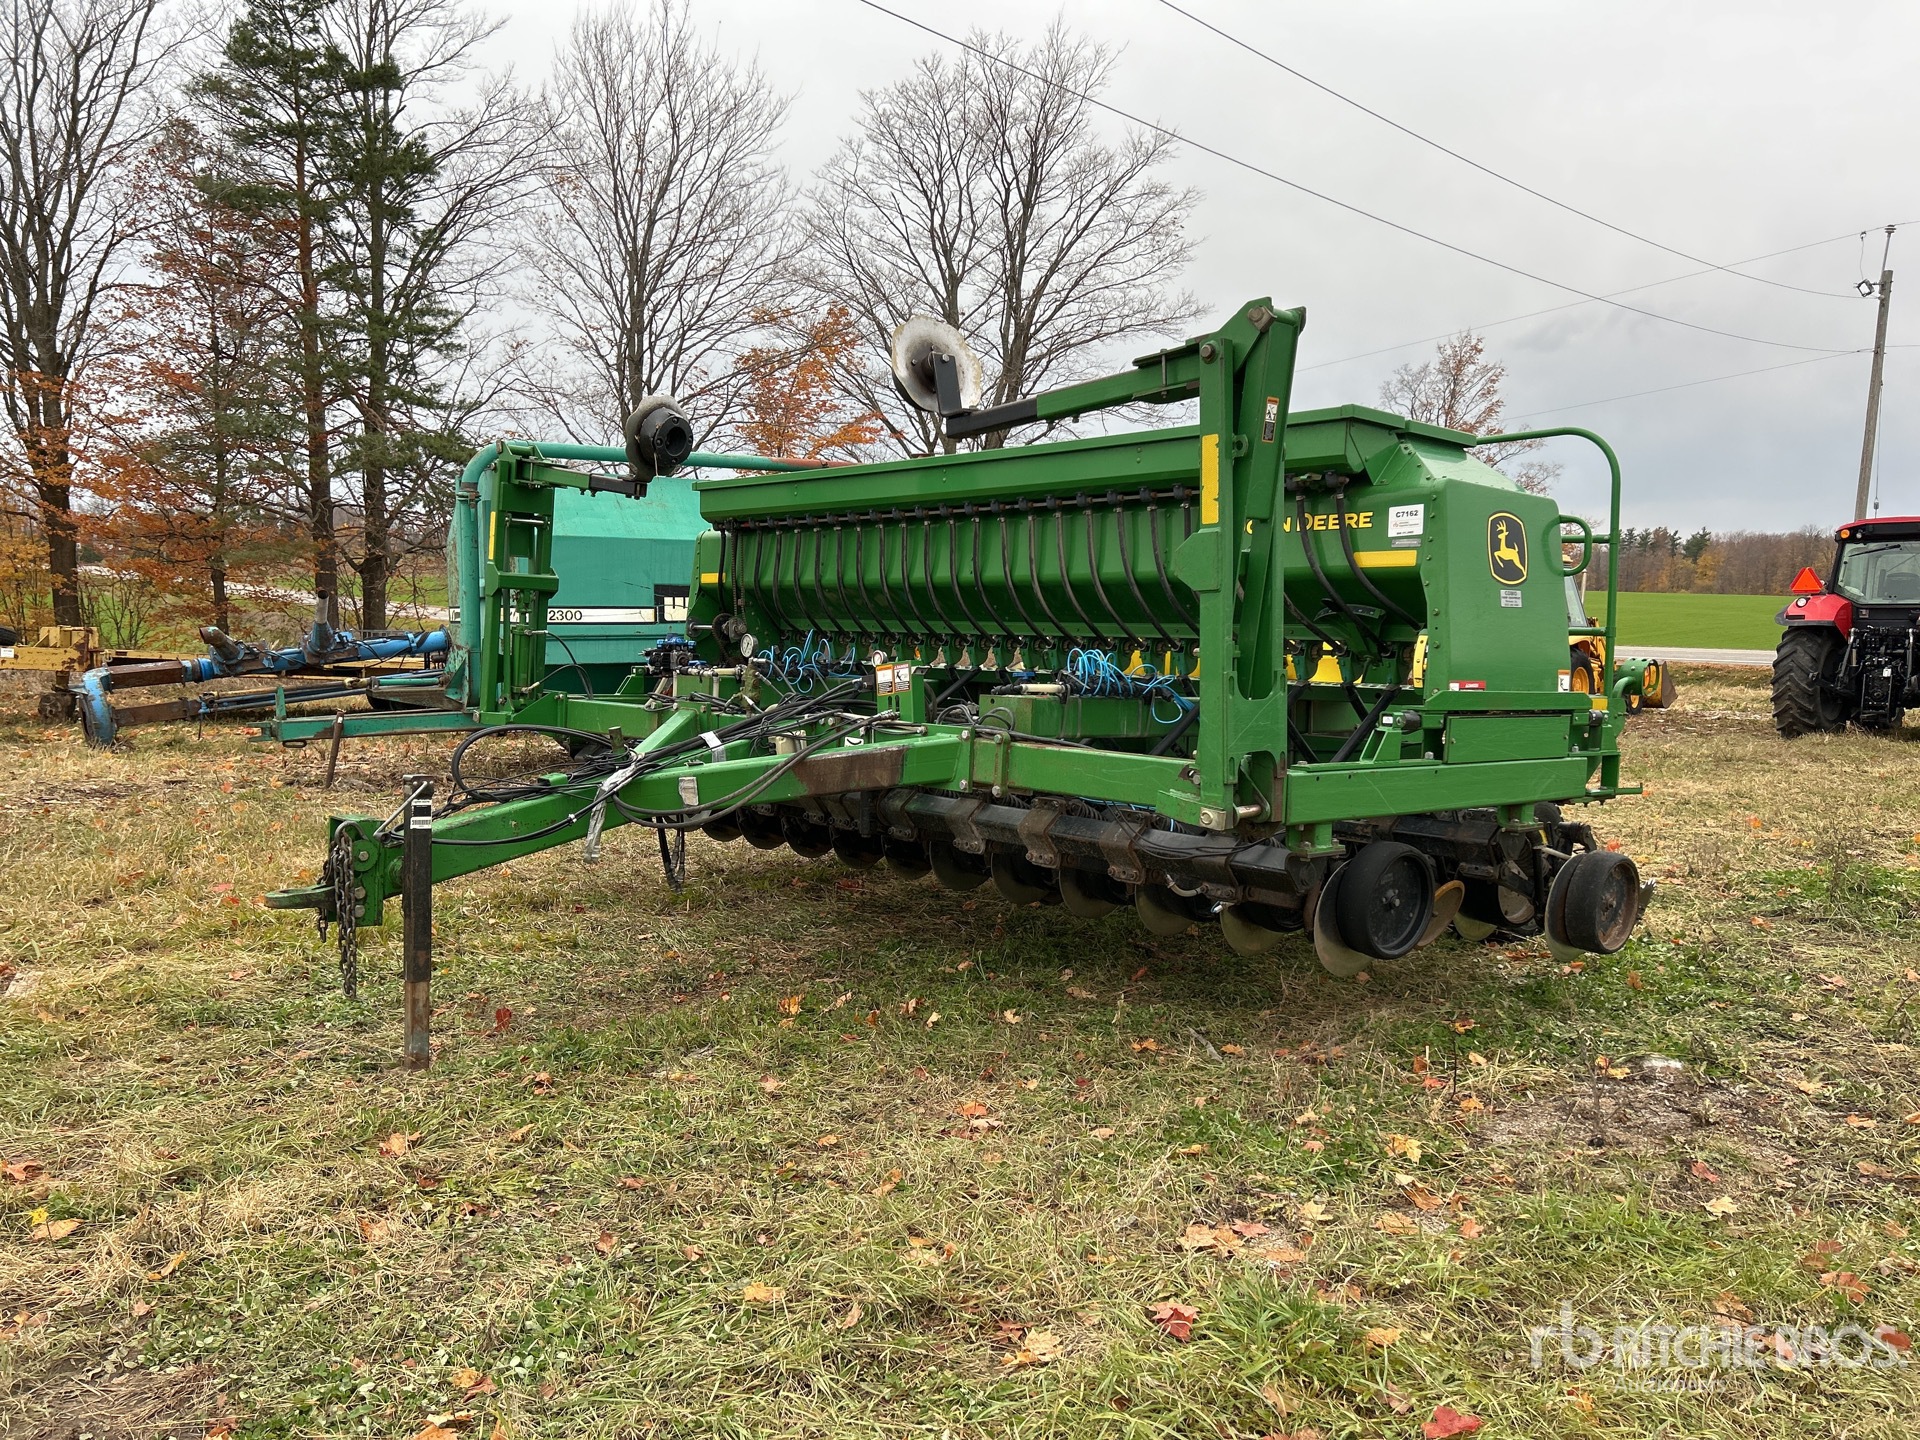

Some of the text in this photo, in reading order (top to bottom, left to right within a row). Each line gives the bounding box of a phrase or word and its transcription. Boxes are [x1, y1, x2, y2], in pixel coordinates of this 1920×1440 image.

[1395, 510, 1419, 518] C7162
[1296, 511, 1374, 532] DEERE
[548, 609, 583, 621] 2300
